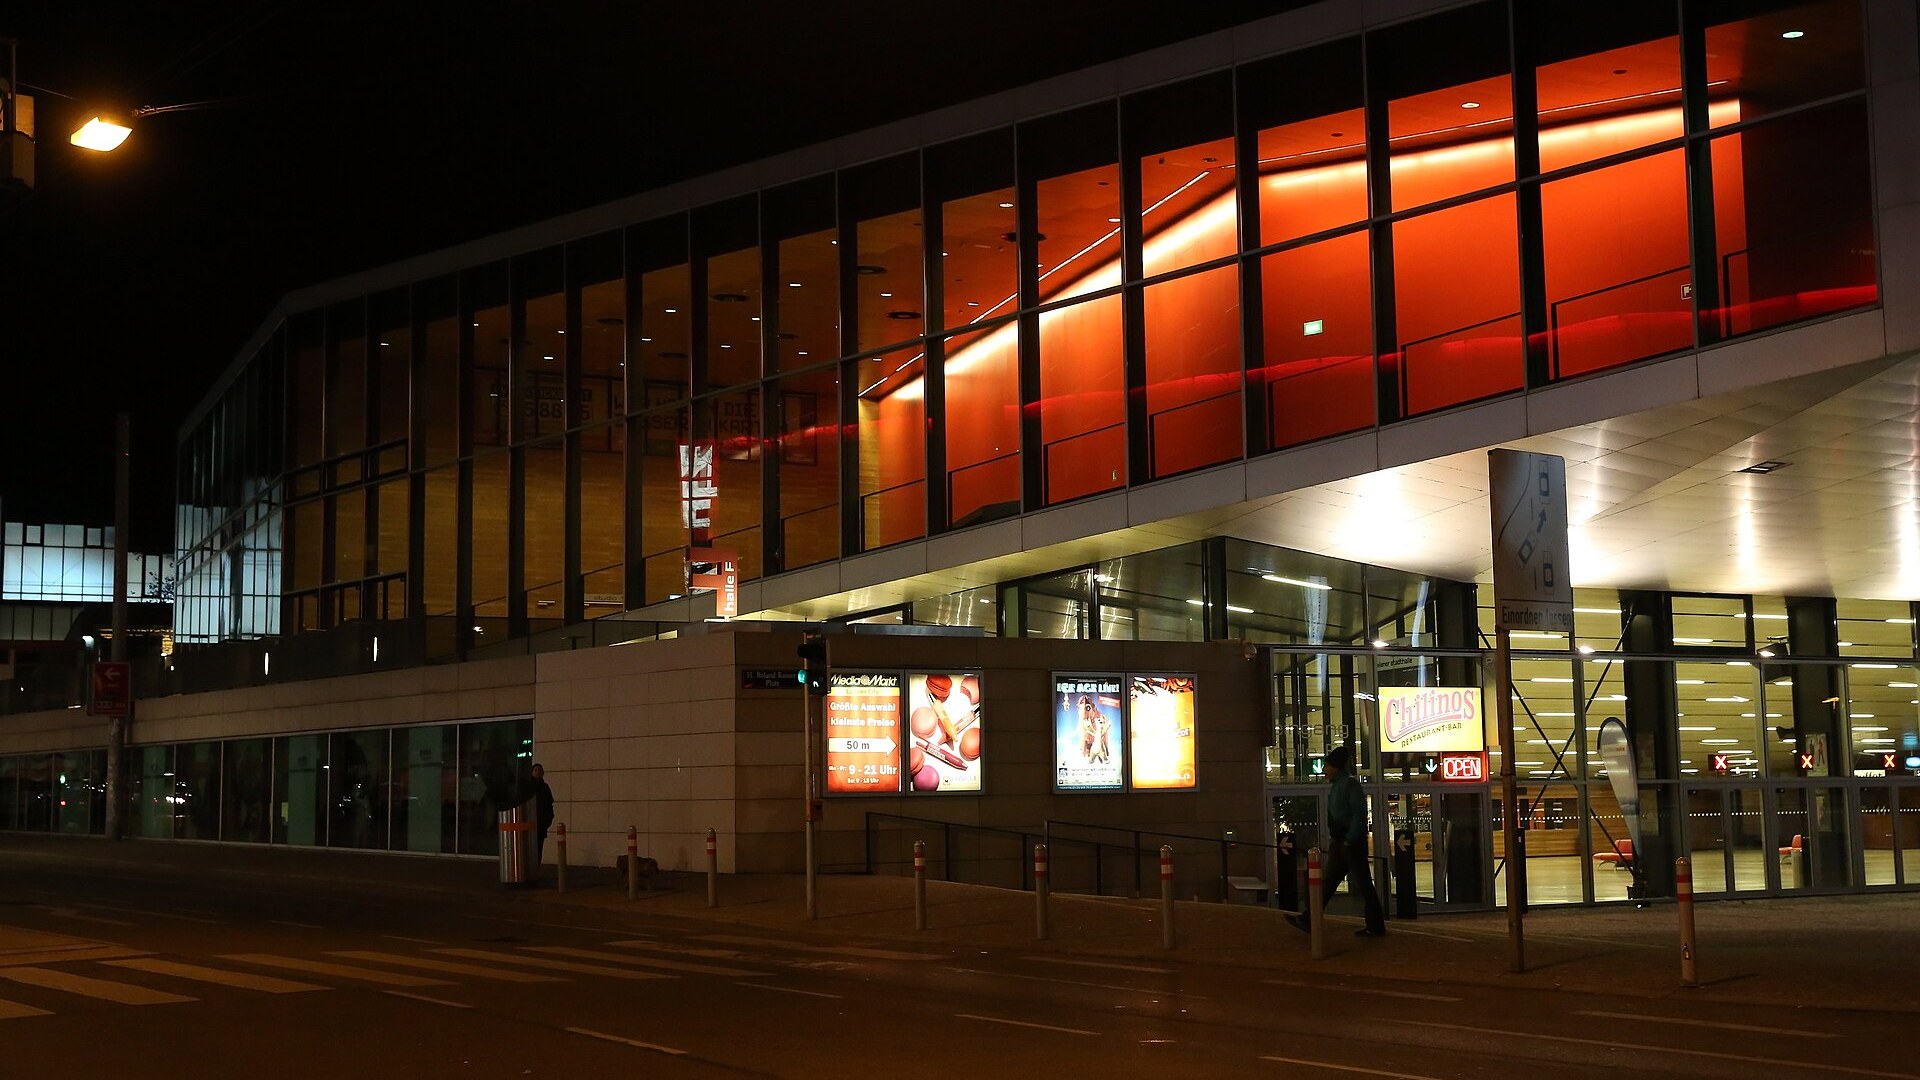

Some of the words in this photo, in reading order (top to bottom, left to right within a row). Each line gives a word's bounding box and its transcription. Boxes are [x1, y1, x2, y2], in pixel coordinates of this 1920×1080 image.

[724, 561, 735, 572] F
[724, 575, 735, 612] halle
[1056, 682, 1076, 693] ICE
[1076, 682, 1098, 693] AGE
[829, 701, 859, 712] Größte
[860, 702, 896, 712] Auswahl
[867, 717, 896, 727] Preise
[846, 740, 859, 750] 50
[861, 742, 870, 750] m
[848, 764, 856, 775] 9
[863, 764, 878, 775] 21
[879, 764, 898, 775] Uhr
[1445, 759, 1479, 777] OPEN
